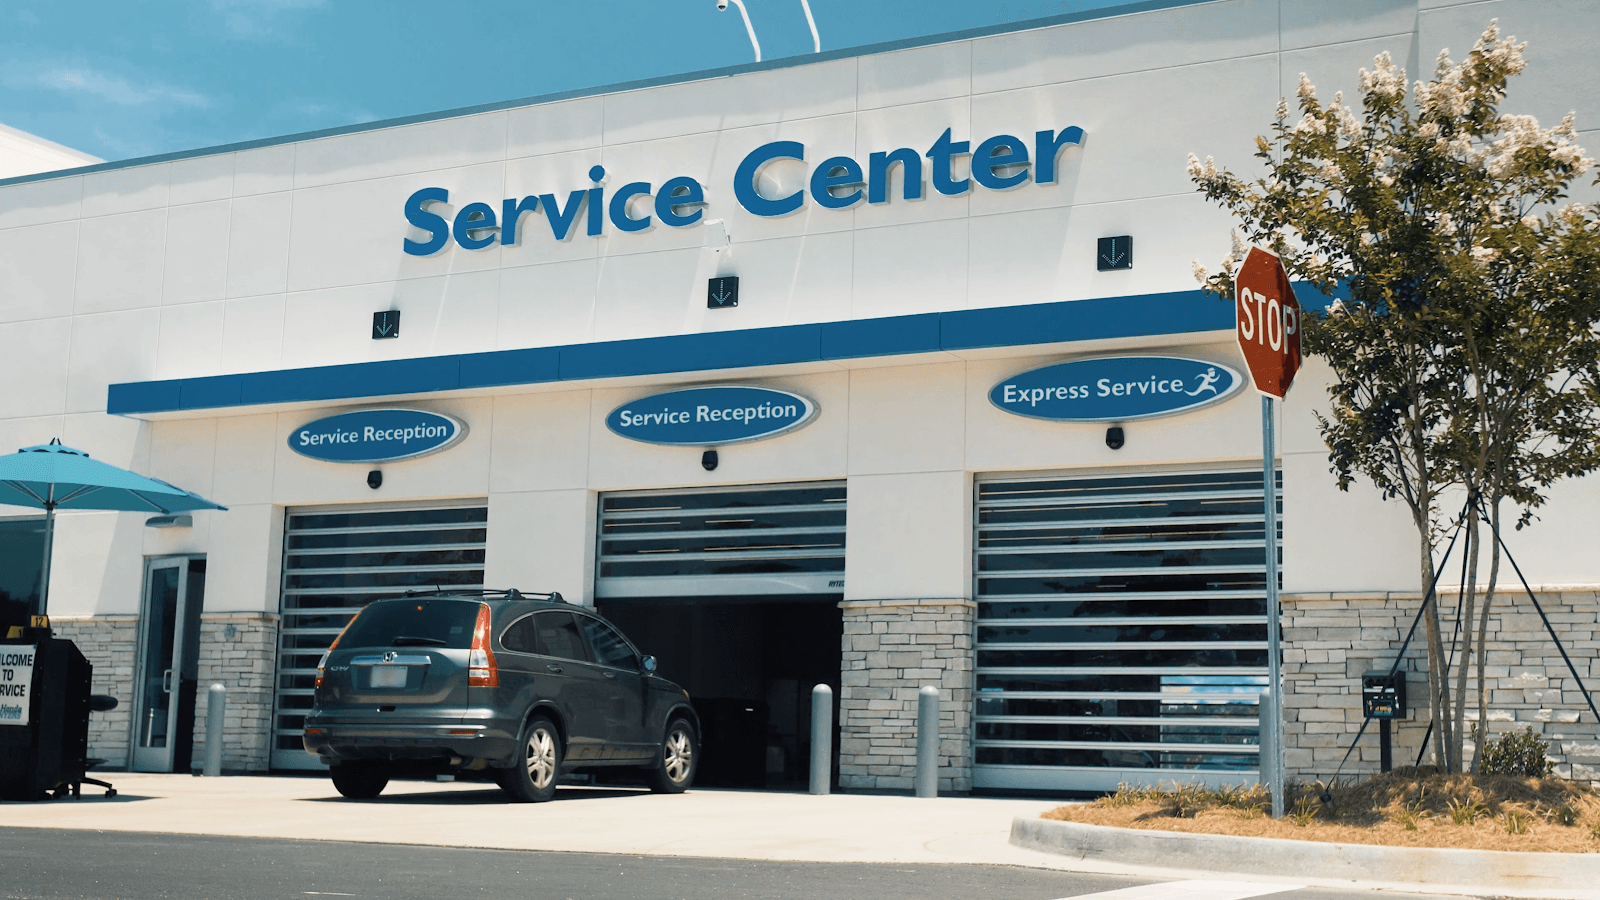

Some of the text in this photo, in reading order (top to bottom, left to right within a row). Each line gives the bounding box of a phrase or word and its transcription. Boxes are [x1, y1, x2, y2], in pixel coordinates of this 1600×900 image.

[403, 126, 1084, 256] Service Center
[1241, 287, 1296, 354] STOP
[1003, 375, 1184, 407] Express Service
[620, 402, 797, 427] Service Reception
[300, 423, 447, 446] Service Reception
[0, 654, 33, 667] LCOME
[2, 669, 14, 681] TO
